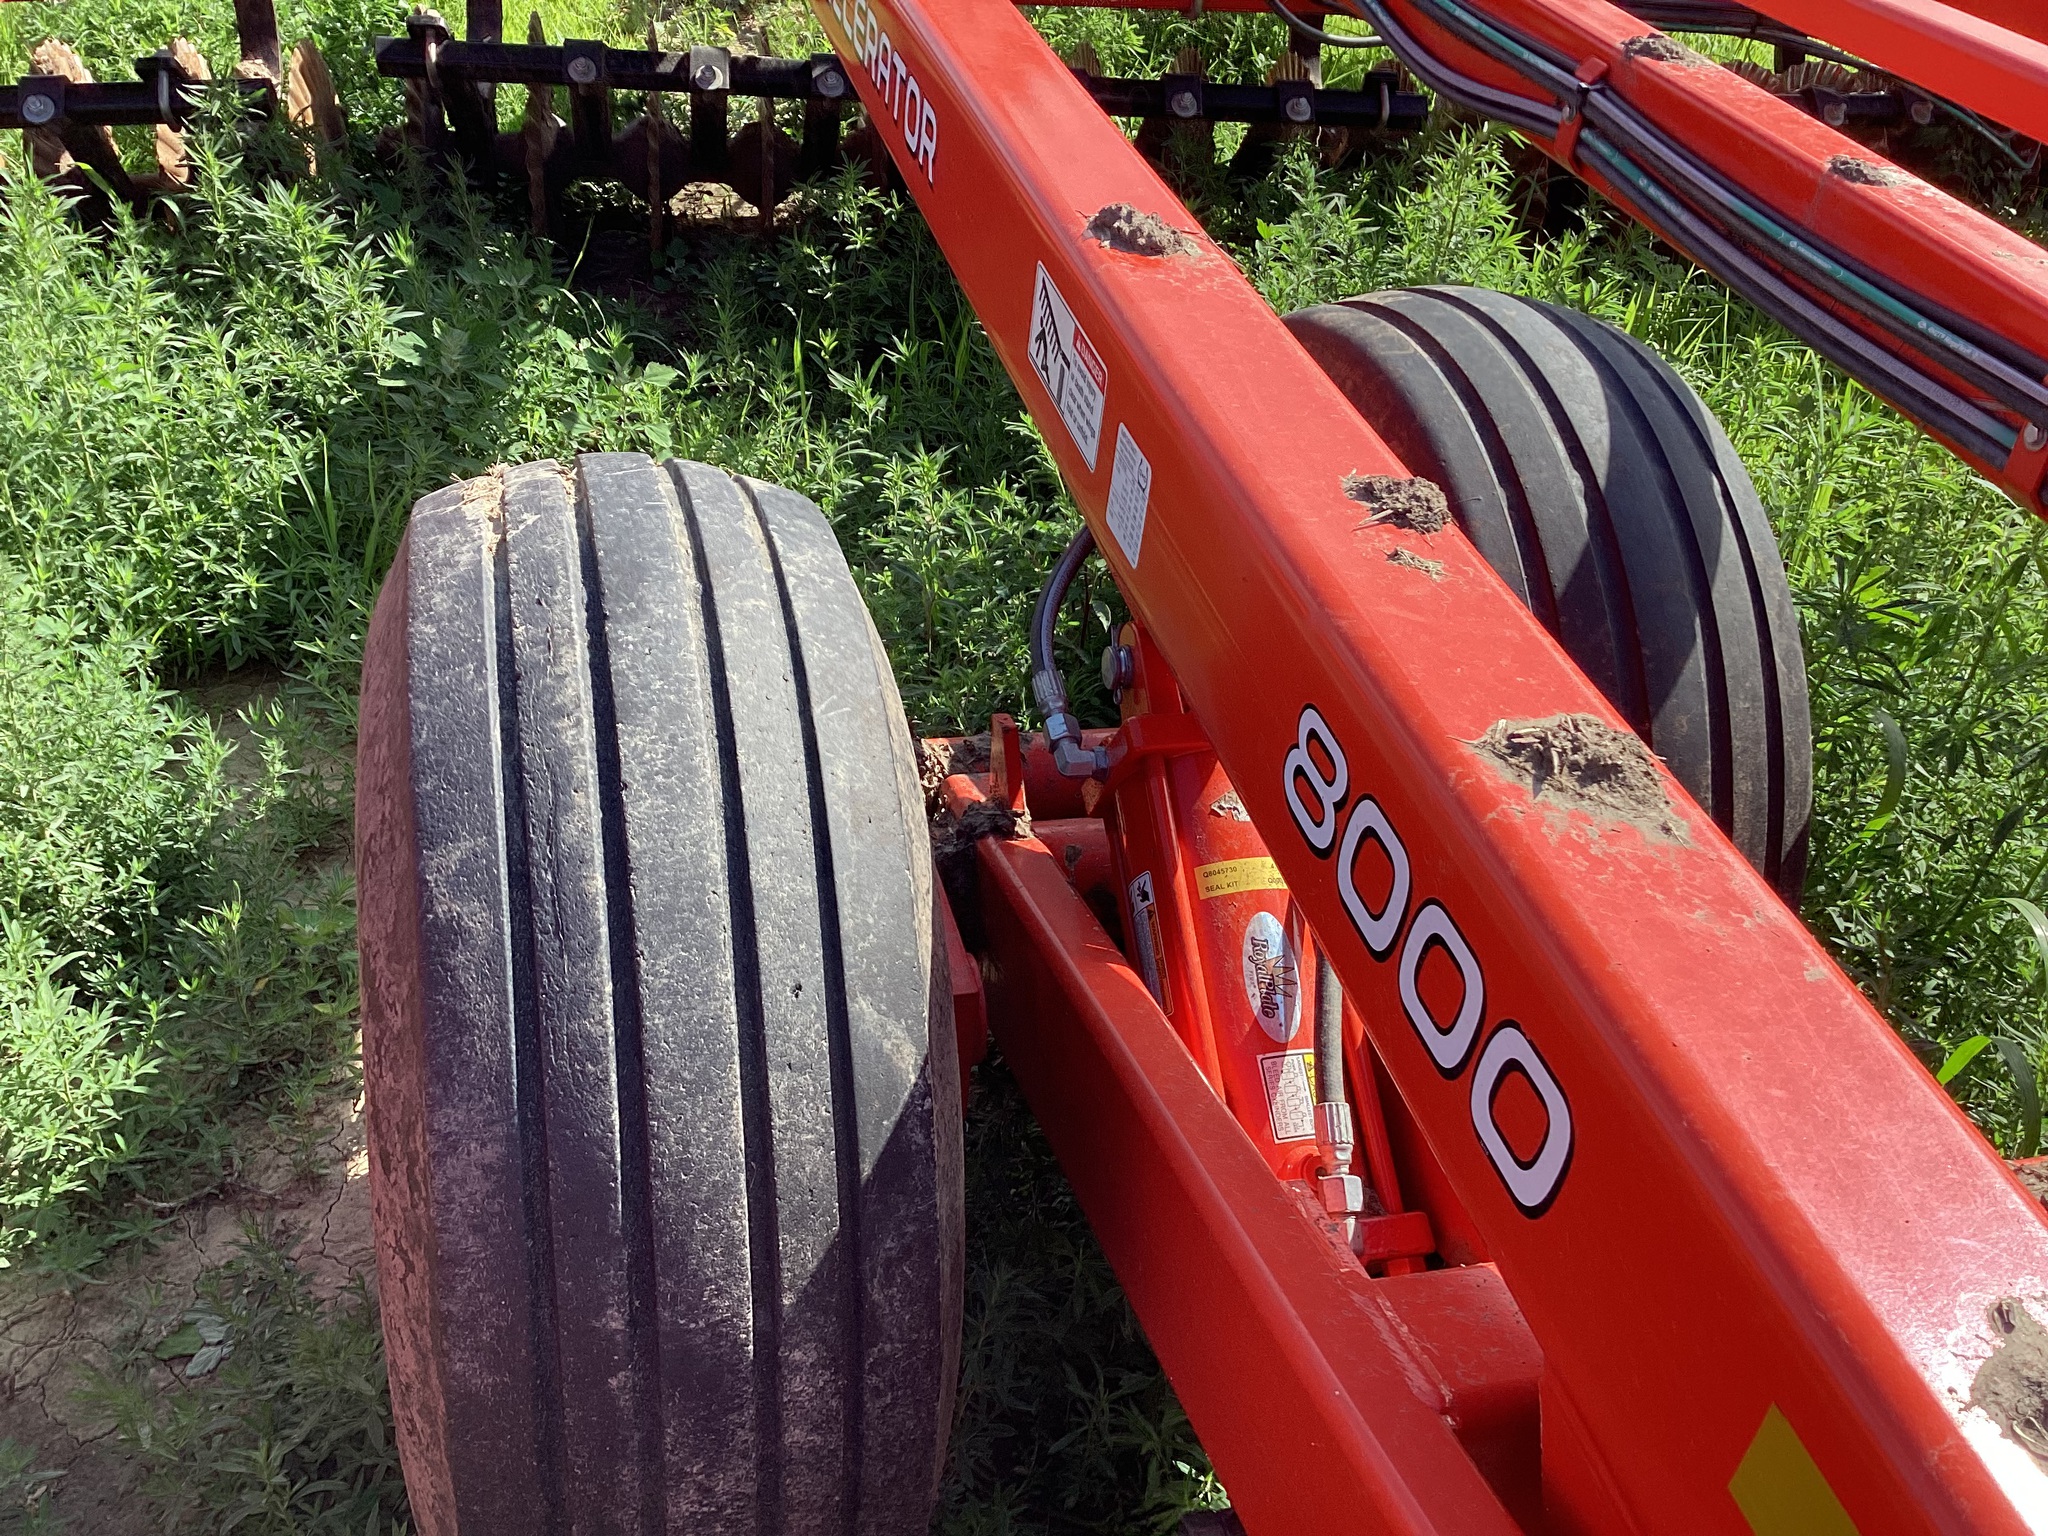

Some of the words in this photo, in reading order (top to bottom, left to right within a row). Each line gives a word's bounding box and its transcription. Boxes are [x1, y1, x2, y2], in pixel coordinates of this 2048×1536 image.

[1203, 866, 1238, 878] Q8045730
[1205, 884, 1225, 893] SEAL
[1284, 706, 1573, 1212] 8000
[1265, 1066, 1276, 1091] SERIES
[1270, 1060, 1280, 1083] BLEED
[1280, 1099, 1288, 1120] FROM
[1270, 1092, 1284, 1132] CYLINDERS
